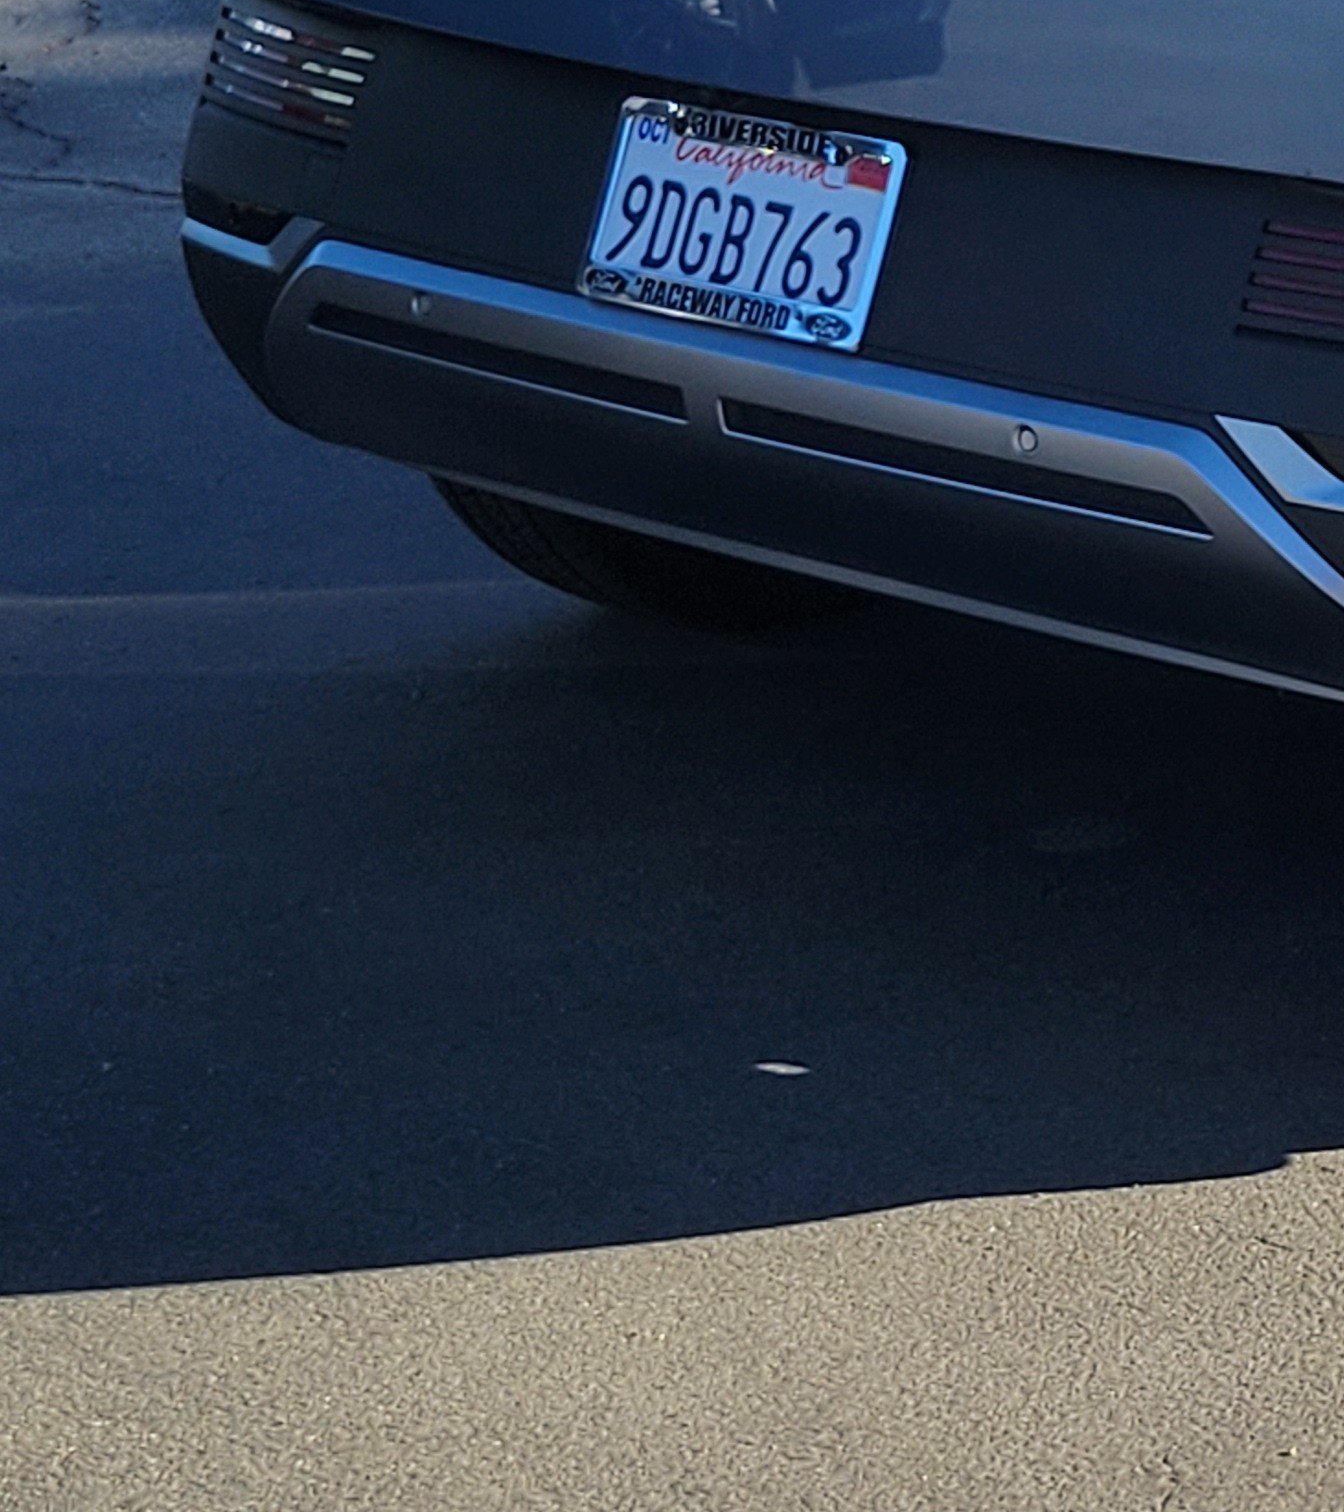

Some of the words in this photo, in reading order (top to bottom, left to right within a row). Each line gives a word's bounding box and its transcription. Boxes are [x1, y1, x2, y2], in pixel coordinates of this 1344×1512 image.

[689, 110, 831, 159] RIVERSIDE
[675, 137, 843, 189] California
[606, 175, 862, 307] 9DGB763
[639, 276, 735, 321] RACEWAY
[737, 296, 791, 330] FORD
